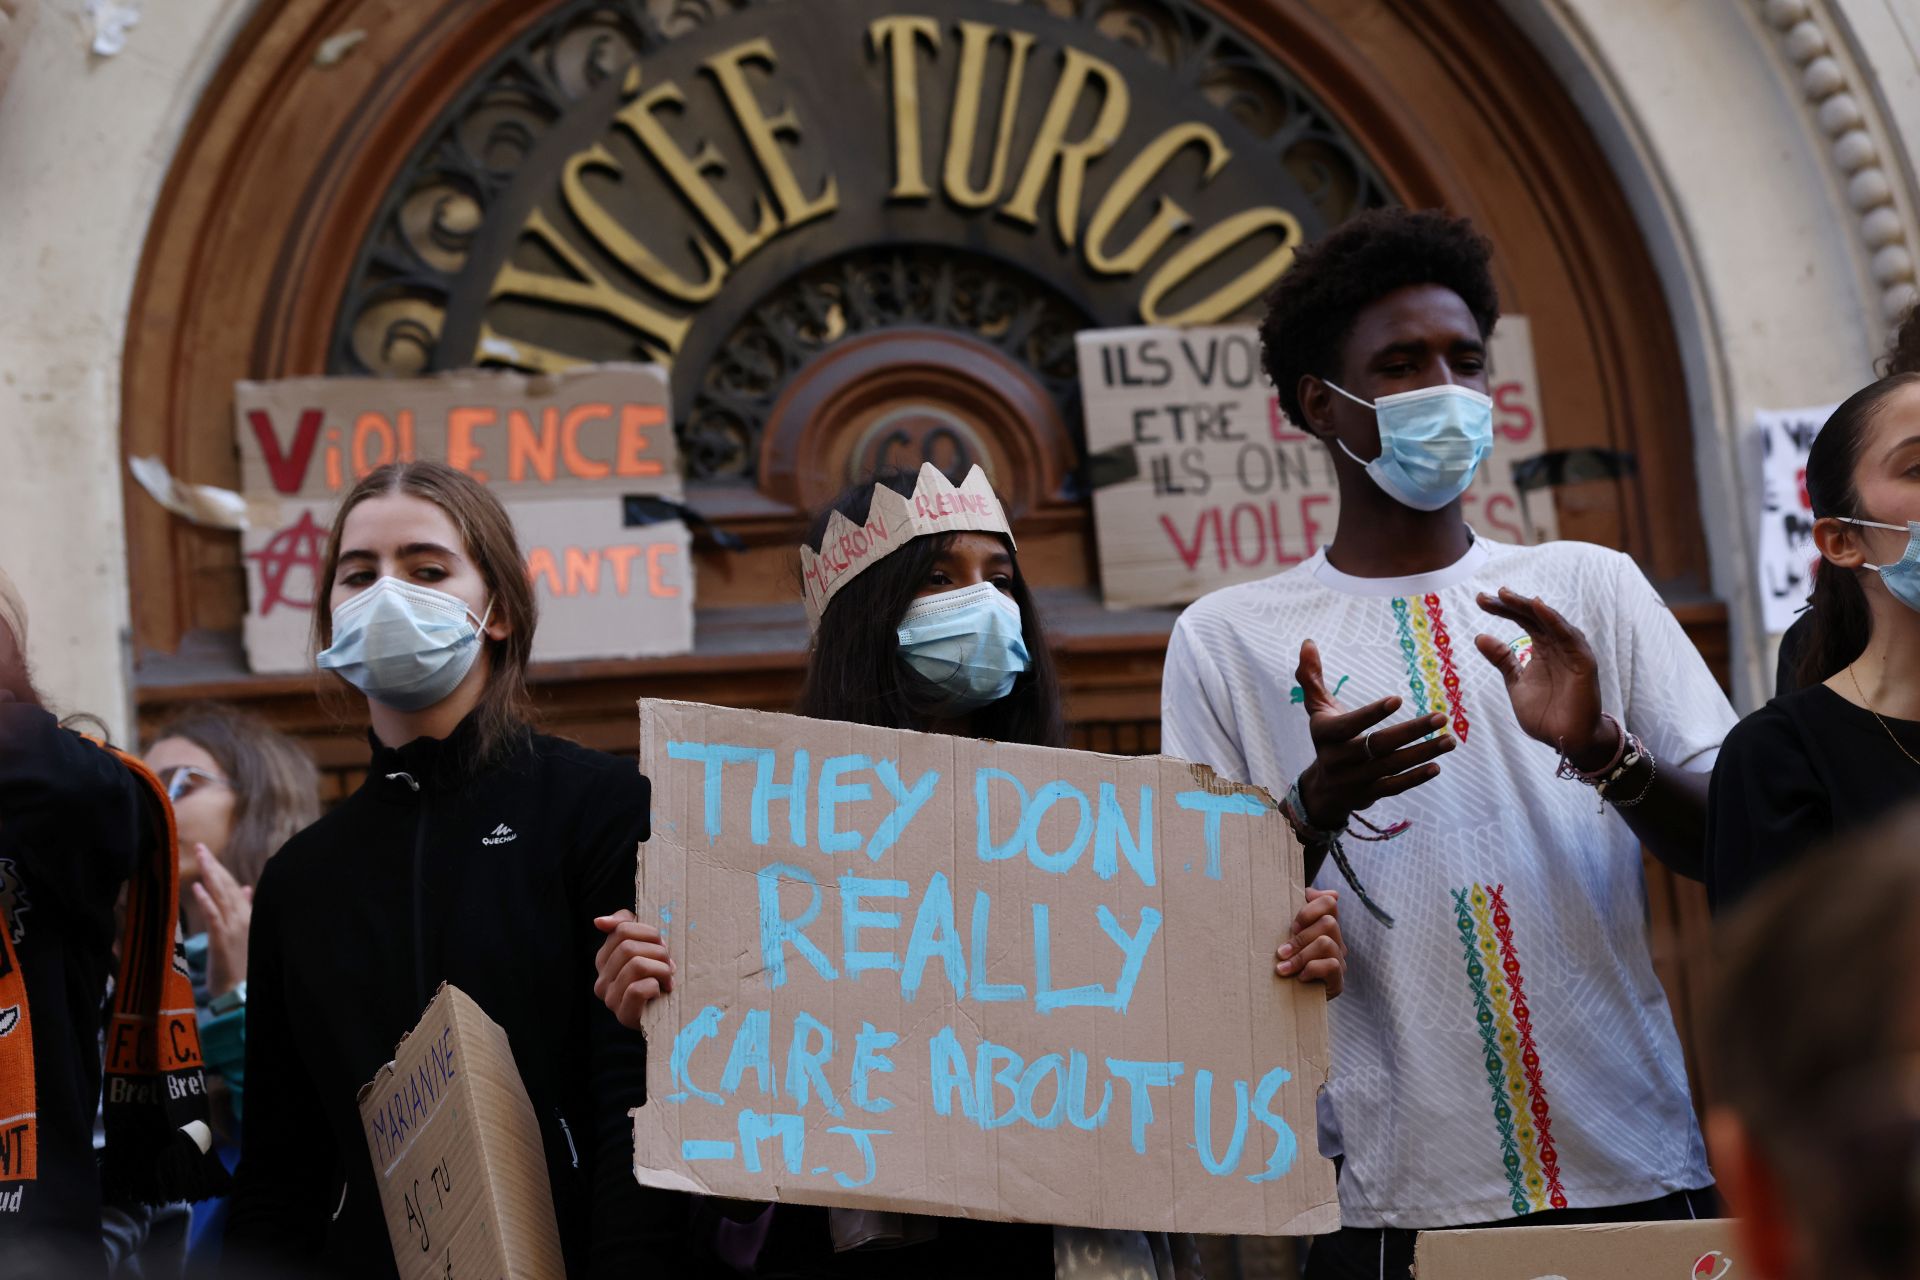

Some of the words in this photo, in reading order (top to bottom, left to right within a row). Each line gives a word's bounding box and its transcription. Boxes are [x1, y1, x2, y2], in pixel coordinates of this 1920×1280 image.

[1102, 336, 1172, 387] ILS
[1133, 401, 1246, 443] ETRE
[1151, 449, 1211, 496] ILS
[805, 516, 888, 607] MACRON
[914, 492, 992, 522] REINE
[482, 833, 518, 846] QUECHUA
[667, 741, 941, 862] THEY
[757, 863, 1162, 1015] REALLY
[373, 1024, 455, 1167] MARIANNE
[664, 1006, 899, 1119] CARE
[929, 1026, 1185, 1154] ABOUT
[1188, 1067, 1298, 1184] US
